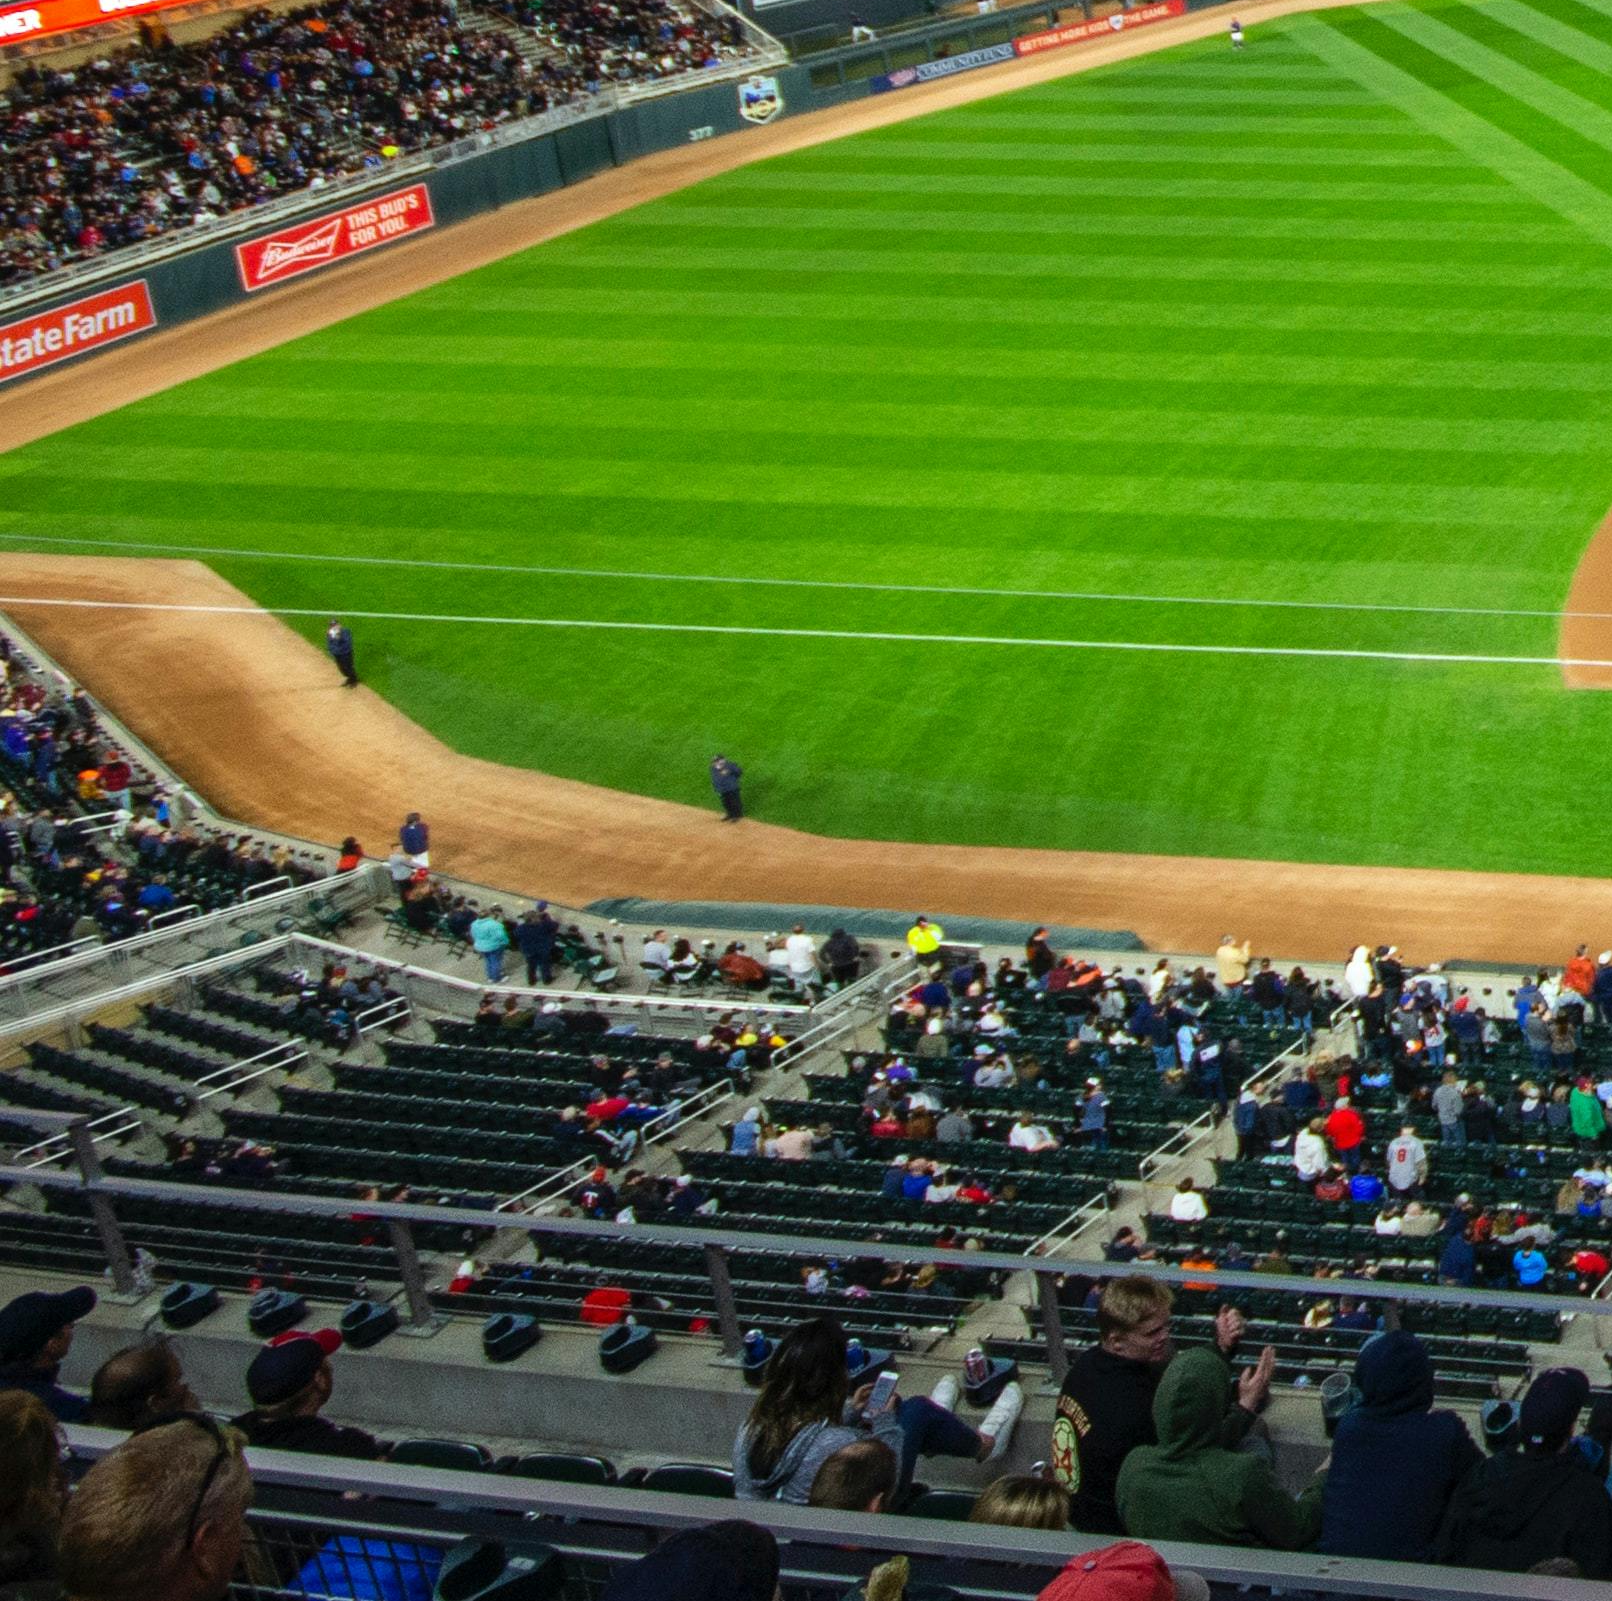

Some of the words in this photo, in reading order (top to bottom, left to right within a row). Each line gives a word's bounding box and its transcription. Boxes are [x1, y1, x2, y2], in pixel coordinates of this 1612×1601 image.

[348, 208, 378, 231] THIS
[379, 193, 418, 222] BUD'S
[264, 234, 335, 269] Budweiser
[349, 226, 376, 248] FOR
